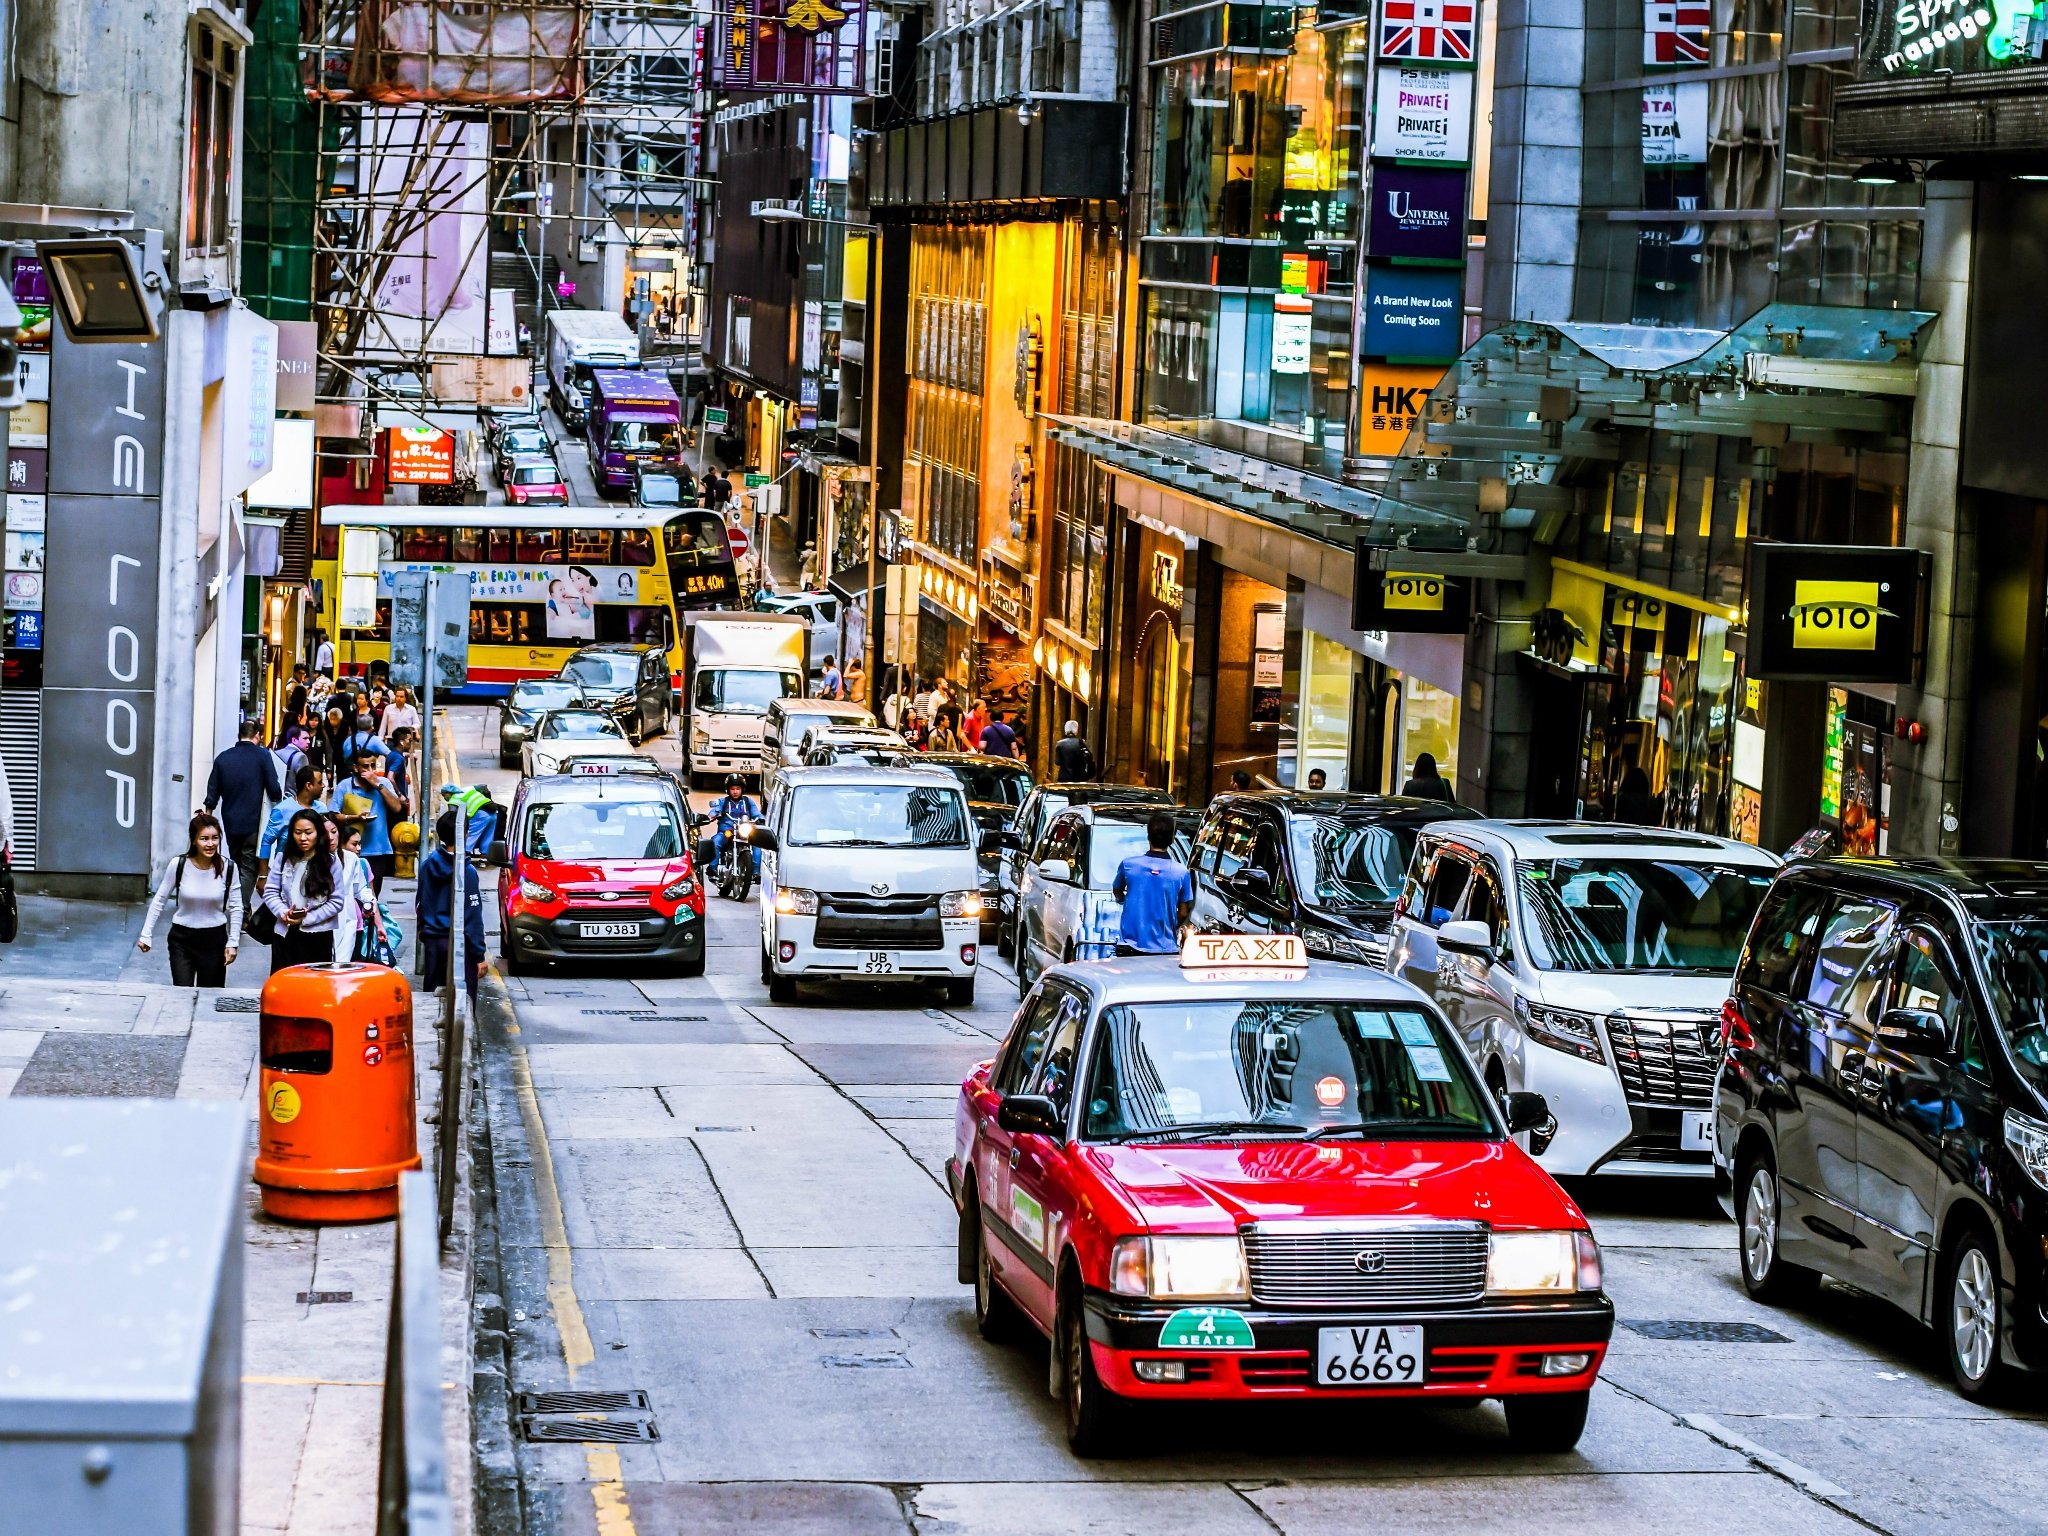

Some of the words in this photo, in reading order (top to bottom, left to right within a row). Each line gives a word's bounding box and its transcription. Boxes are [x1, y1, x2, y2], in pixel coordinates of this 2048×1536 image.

[732, 0, 747, 70] ANT
[1883, 9, 1990, 72] massage
[1399, 90, 1442, 109] PRIVATE
[1397, 115, 1442, 133] PRIVATE
[1395, 148, 1417, 156] SHOP
[1387, 190, 1450, 220] UNIVERSAL
[1399, 218, 1449, 226] JEWELLERY
[1374, 295, 1381, 305] A
[1383, 295, 1409, 306] Brand
[1410, 296, 1430, 307] New
[1432, 298, 1453, 308] Look
[1384, 313, 1417, 327] Coming
[1418, 316, 1440, 326] Soon
[1372, 385, 1434, 416] HKT
[1389, 579, 1440, 597] 1010
[1800, 606, 1871, 630] 1010
[105, 554, 142, 828] LOOP
[580, 765, 609, 774] TAXI
[584, 925, 600, 935] TU
[605, 925, 637, 935] 9383
[870, 952, 888, 963] UB
[1198, 939, 1295, 960] TAXI
[864, 963, 892, 974] 522
[1197, 1315, 1216, 1335] 4
[1179, 1335, 1235, 1346] SEATS
[1350, 1327, 1394, 1355] VA
[1326, 1354, 1417, 1382] 6669
